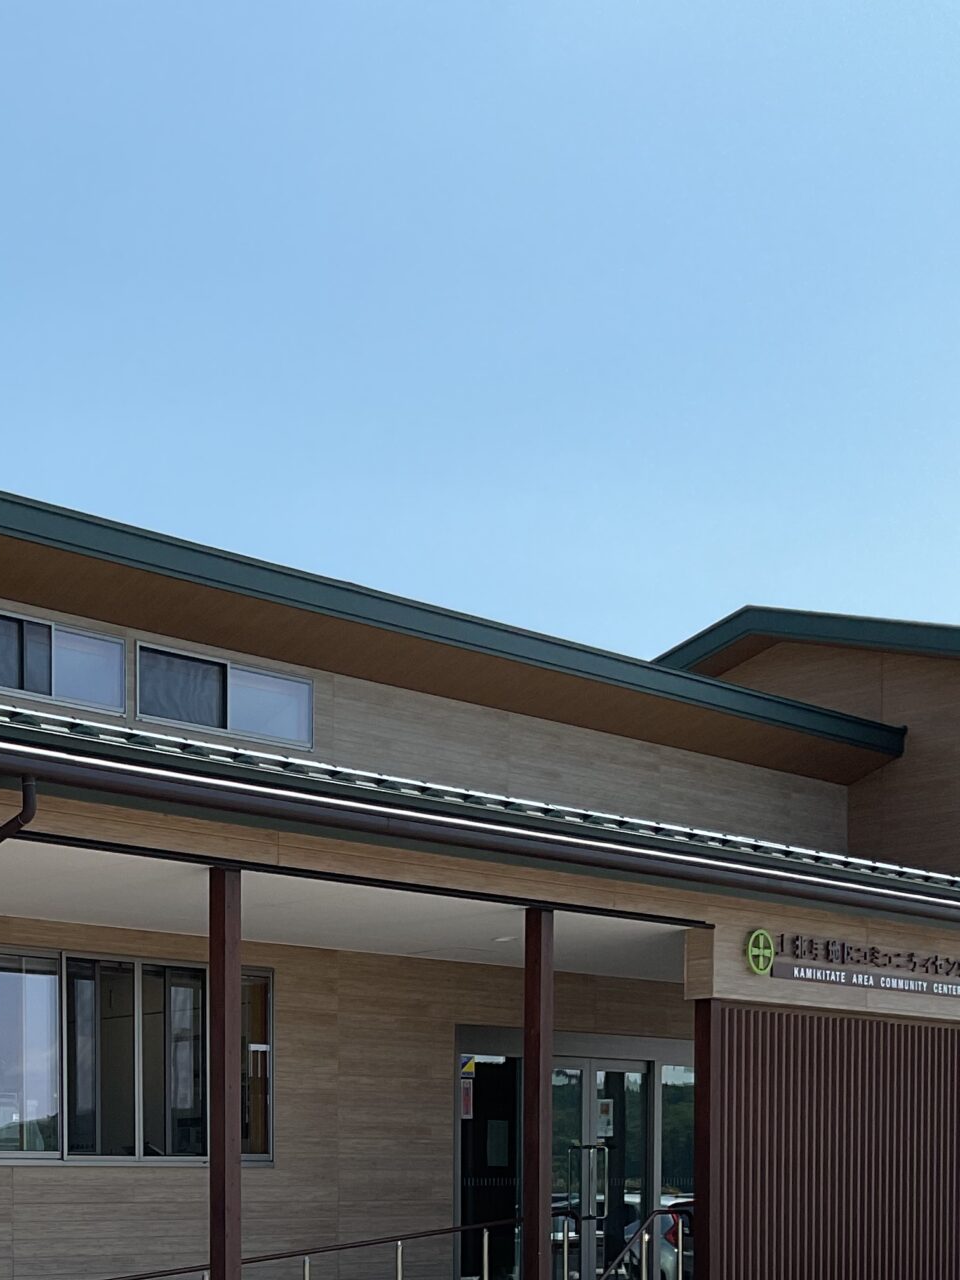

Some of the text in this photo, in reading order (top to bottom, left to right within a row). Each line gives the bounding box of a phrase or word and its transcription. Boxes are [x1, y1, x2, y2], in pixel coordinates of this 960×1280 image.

[793, 966, 846, 983] KAMIKITATE
[852, 974, 874, 986] AREA
[880, 977, 927, 991] COMMUNITY
